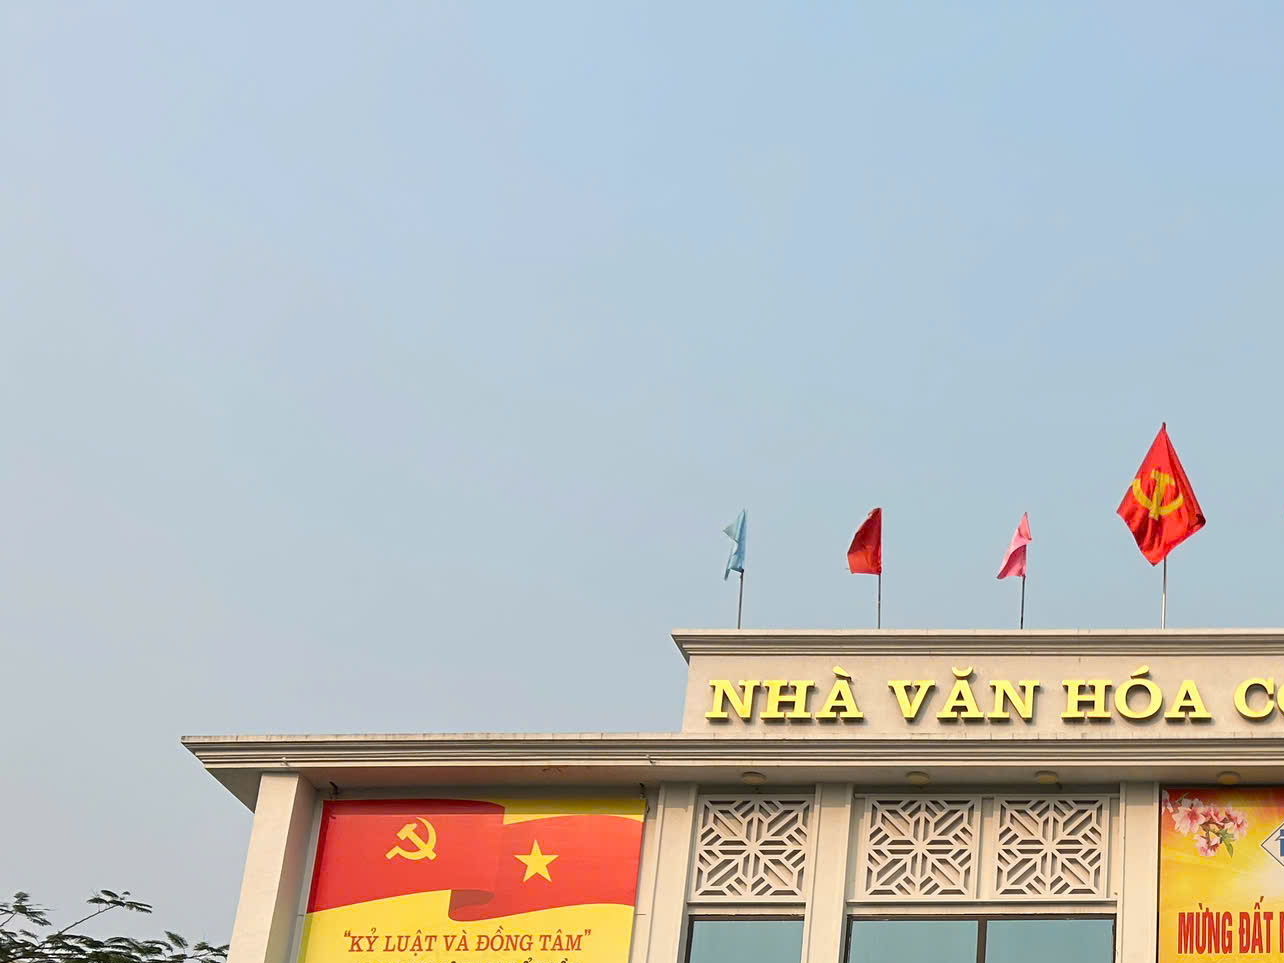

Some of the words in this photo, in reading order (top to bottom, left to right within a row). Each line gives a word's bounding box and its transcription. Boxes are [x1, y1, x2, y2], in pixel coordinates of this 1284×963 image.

[705, 666, 864, 720] NHÀ
[888, 665, 1040, 719] VĂN
[1060, 666, 1212, 720] HÓA
[344, 928, 377, 952] “KỶ
[383, 930, 437, 956] LUẬT
[443, 930, 469, 951] VÀ
[475, 926, 534, 951] ĐỒNG
[539, 928, 592, 951] TÂM”
[1177, 902, 1233, 954] MỪNG
[1238, 895, 1274, 953] ĐẤT
